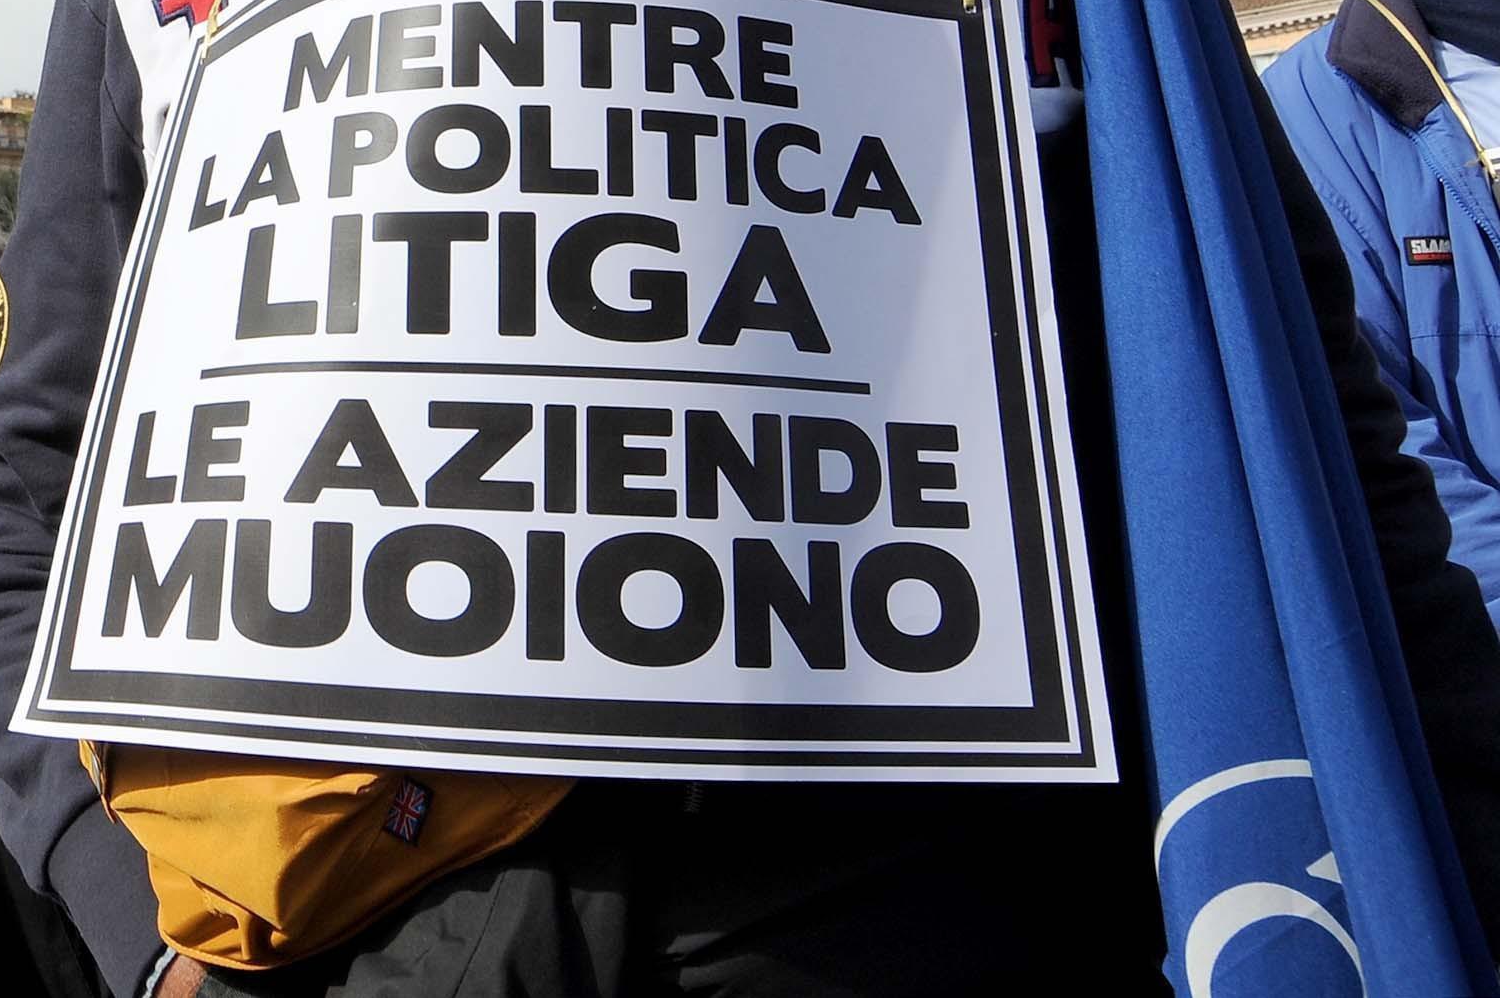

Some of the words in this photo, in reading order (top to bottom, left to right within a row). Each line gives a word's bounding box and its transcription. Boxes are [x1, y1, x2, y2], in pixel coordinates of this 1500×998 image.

[284, 0, 799, 110] MENTRE
[188, 129, 301, 233] LA
[327, 104, 923, 226] POLITICA
[234, 211, 832, 355] LITIGA
[122, 400, 250, 507] LE
[283, 398, 971, 530] AZIENDE
[100, 518, 981, 674] MUOIONO
